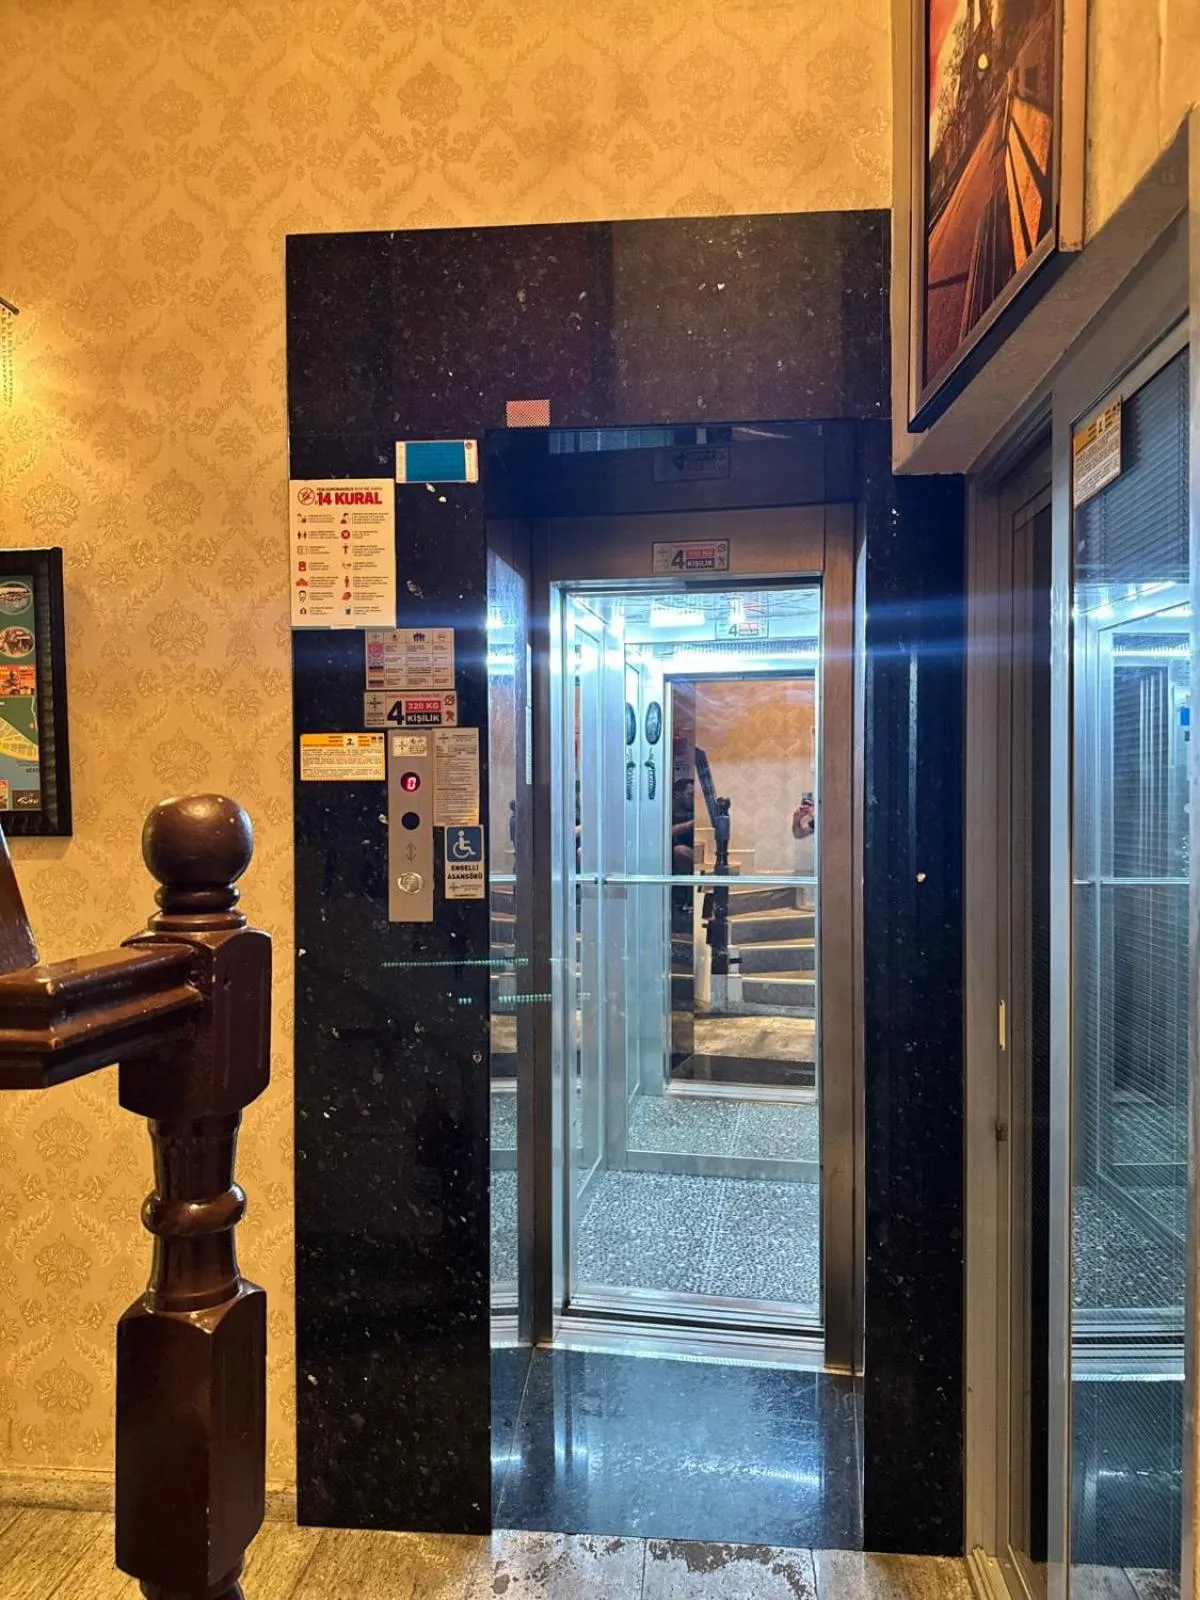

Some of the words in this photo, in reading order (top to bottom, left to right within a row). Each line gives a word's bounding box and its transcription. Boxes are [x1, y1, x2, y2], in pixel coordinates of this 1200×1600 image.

[317, 492, 332, 506] 14
[335, 492, 382, 505] KURAL
[671, 550, 686, 569] 4
[387, 700, 405, 725] 4
[408, 702, 424, 710] 320
[426, 702, 439, 710] KG
[407, 713, 440, 724] KİŞİLİK
